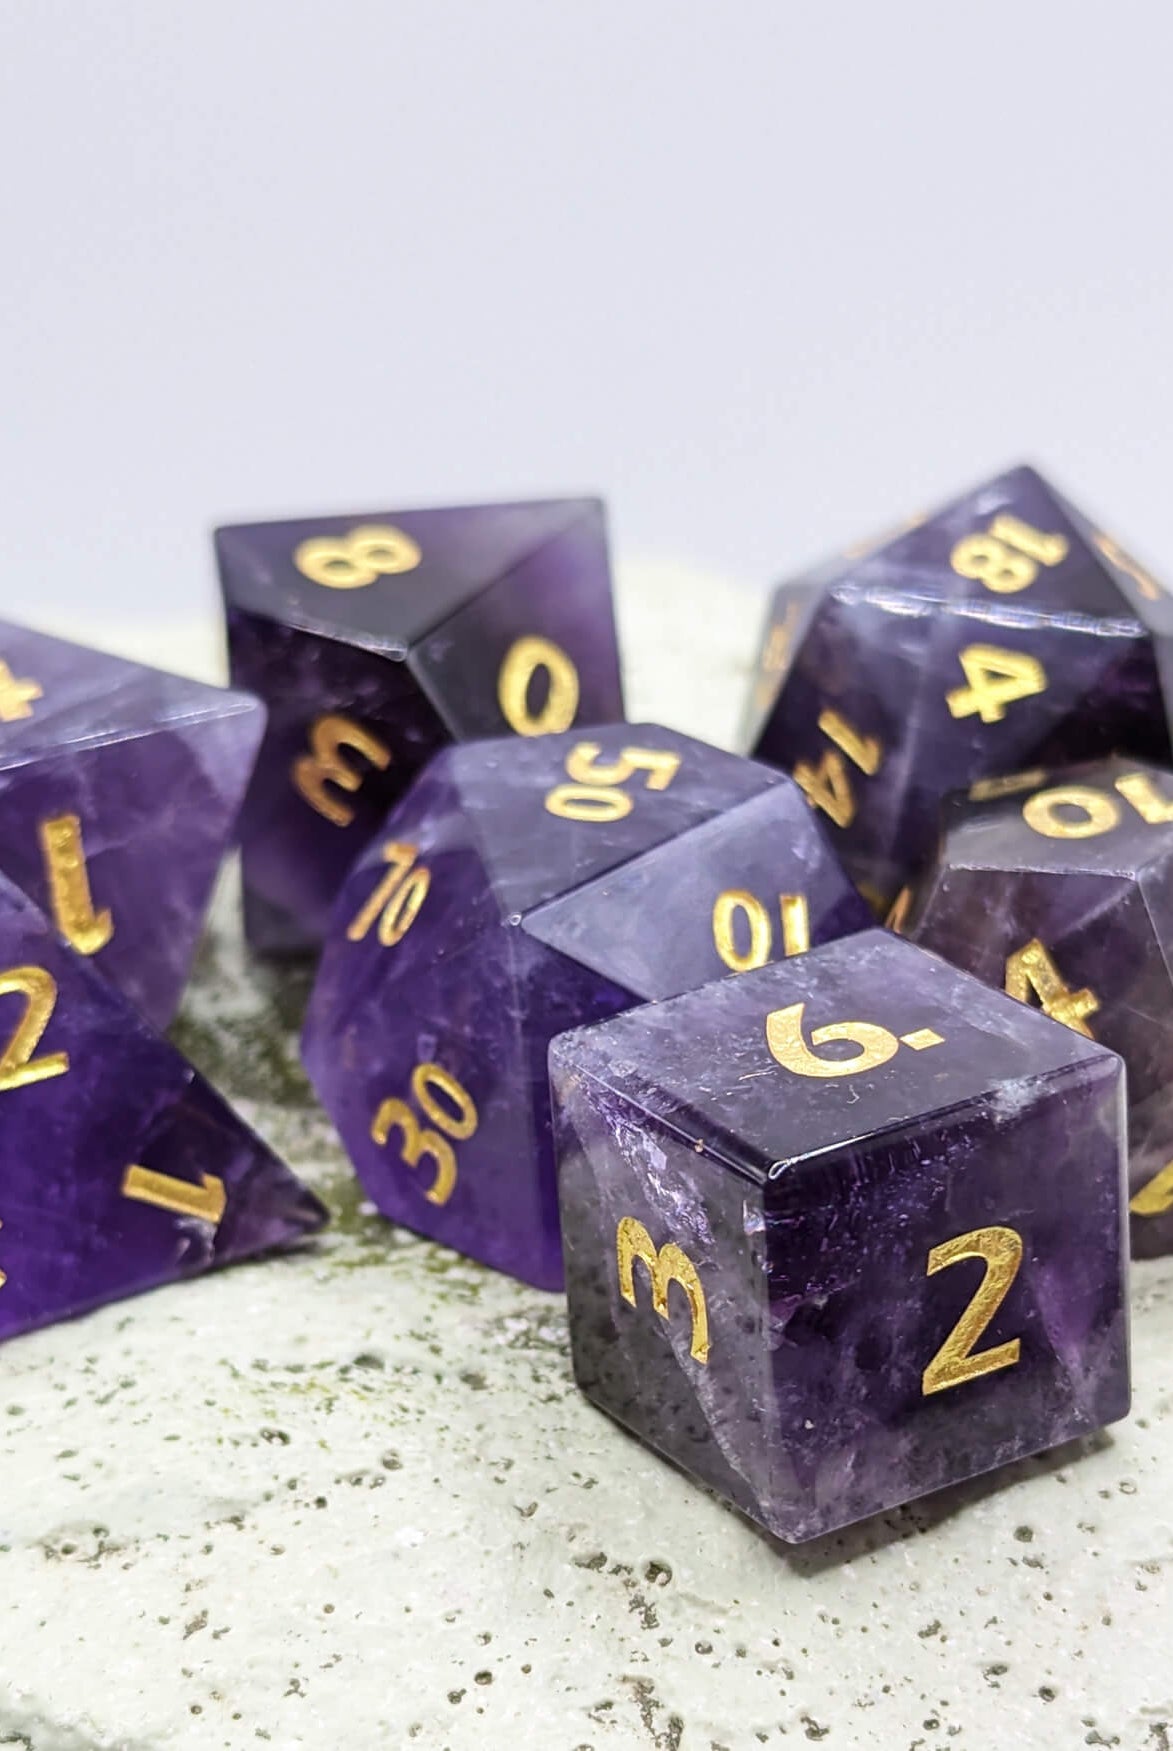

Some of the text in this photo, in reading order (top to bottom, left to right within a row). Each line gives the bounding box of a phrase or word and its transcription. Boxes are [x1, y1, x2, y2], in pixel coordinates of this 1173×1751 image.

[293, 523, 423, 590] 8
[949, 513, 1069, 594] 18
[497, 634, 580, 738] 0
[945, 643, 1048, 724] 4
[292, 714, 391, 828] 3
[545, 742, 681, 823] 50
[793, 707, 883, 829] 14
[41, 812, 115, 956] 1
[0, 966, 70, 1091] 2
[1004, 938, 1099, 1040] 4
[371, 1062, 478, 1207] 30
[122, 1164, 227, 1224] 1
[616, 1216, 709, 1365] 3
[922, 1225, 1024, 1396] 2
